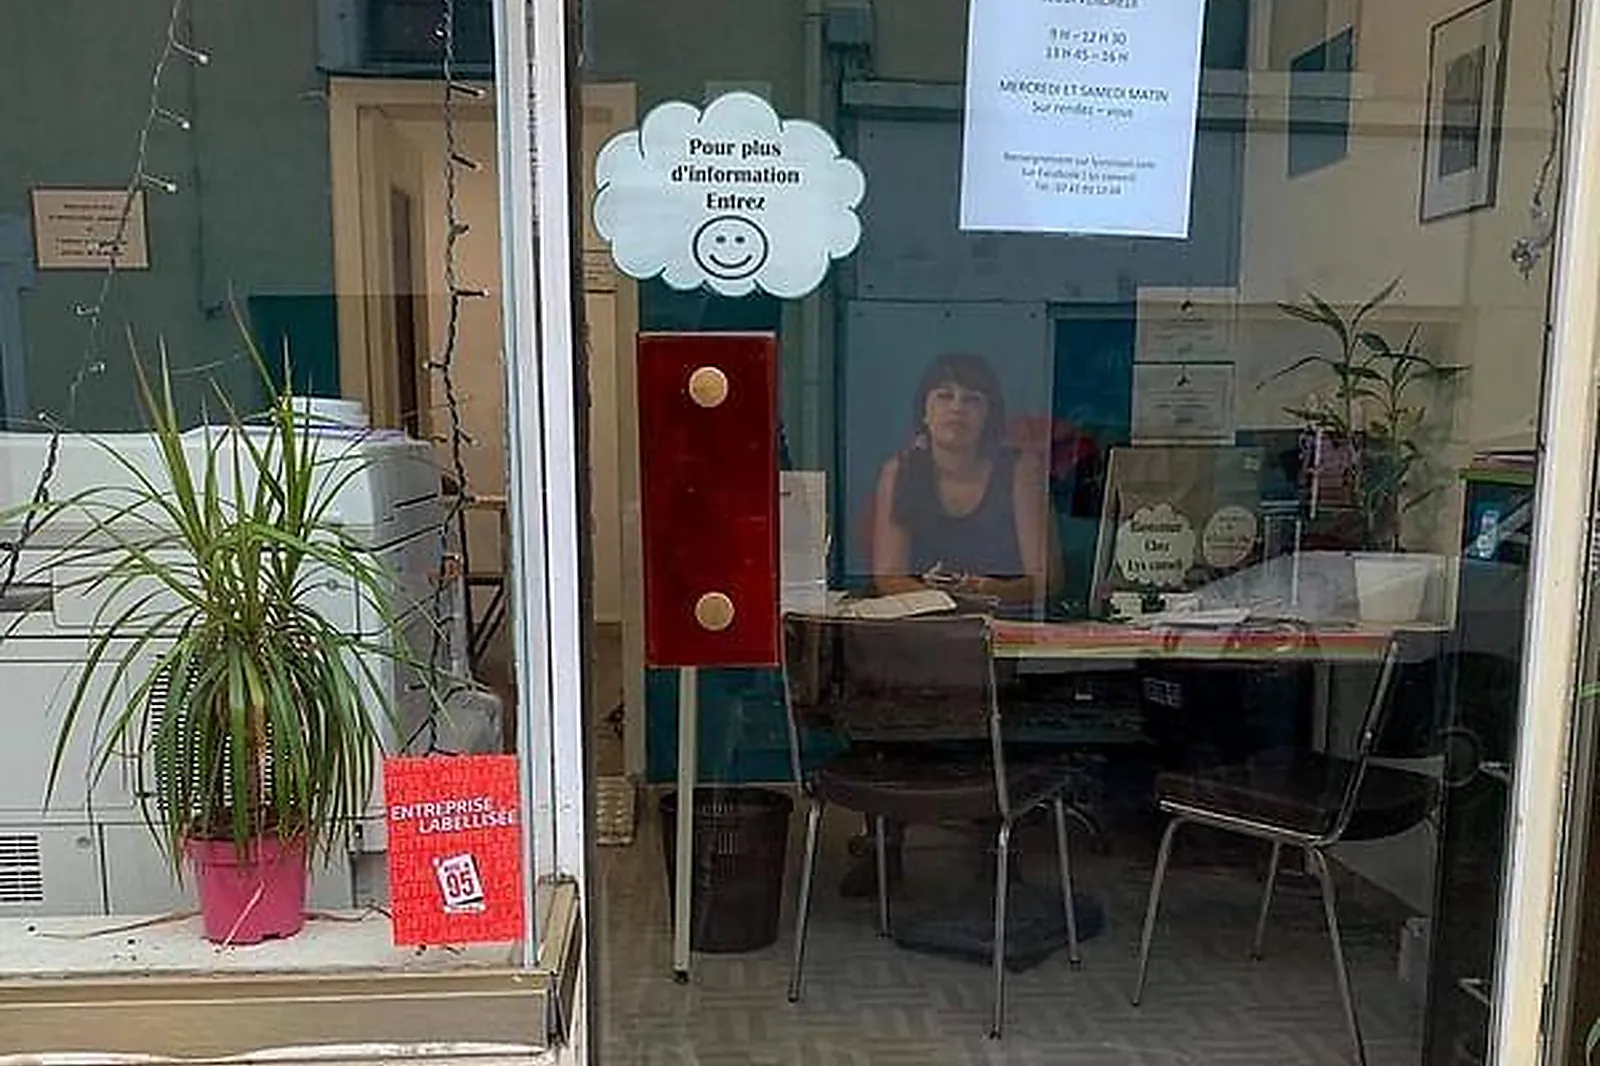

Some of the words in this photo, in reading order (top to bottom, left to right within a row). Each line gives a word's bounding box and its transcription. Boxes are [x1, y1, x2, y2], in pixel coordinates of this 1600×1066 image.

[1000, 79, 1061, 95] MERCREDI
[1063, 83, 1078, 97] ET
[1079, 84, 1127, 100] SAMEDI
[1128, 87, 1170, 102] MATIN
[1032, 100, 1051, 113] Sur
[689, 138, 735, 156] Pour
[741, 139, 782, 160] plus
[671, 165, 800, 183] d'information
[706, 192, 766, 211] Entrez
[390, 796, 494, 821] ENTREPRISE
